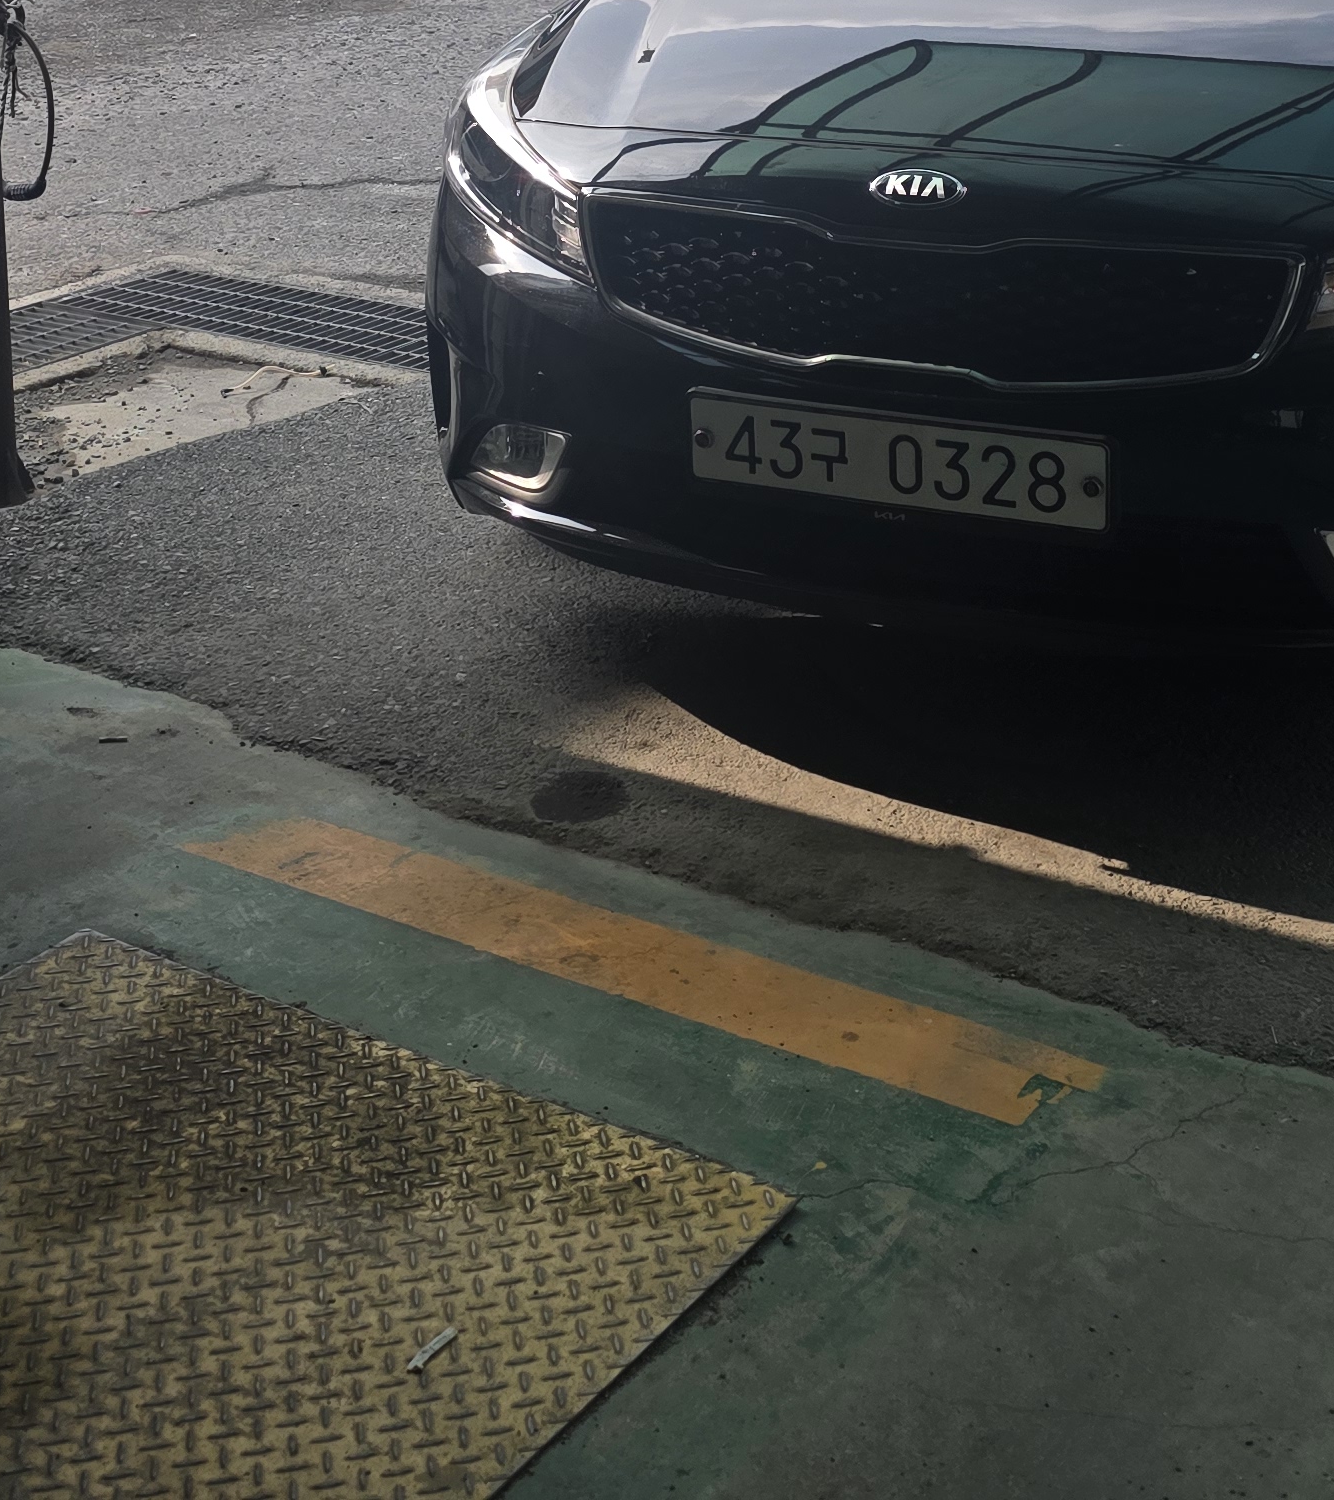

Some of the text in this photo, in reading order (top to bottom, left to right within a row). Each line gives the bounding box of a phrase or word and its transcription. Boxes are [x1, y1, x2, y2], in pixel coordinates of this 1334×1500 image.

[885, 174, 945, 199] KIA
[725, 415, 1067, 513] 43구 0328
